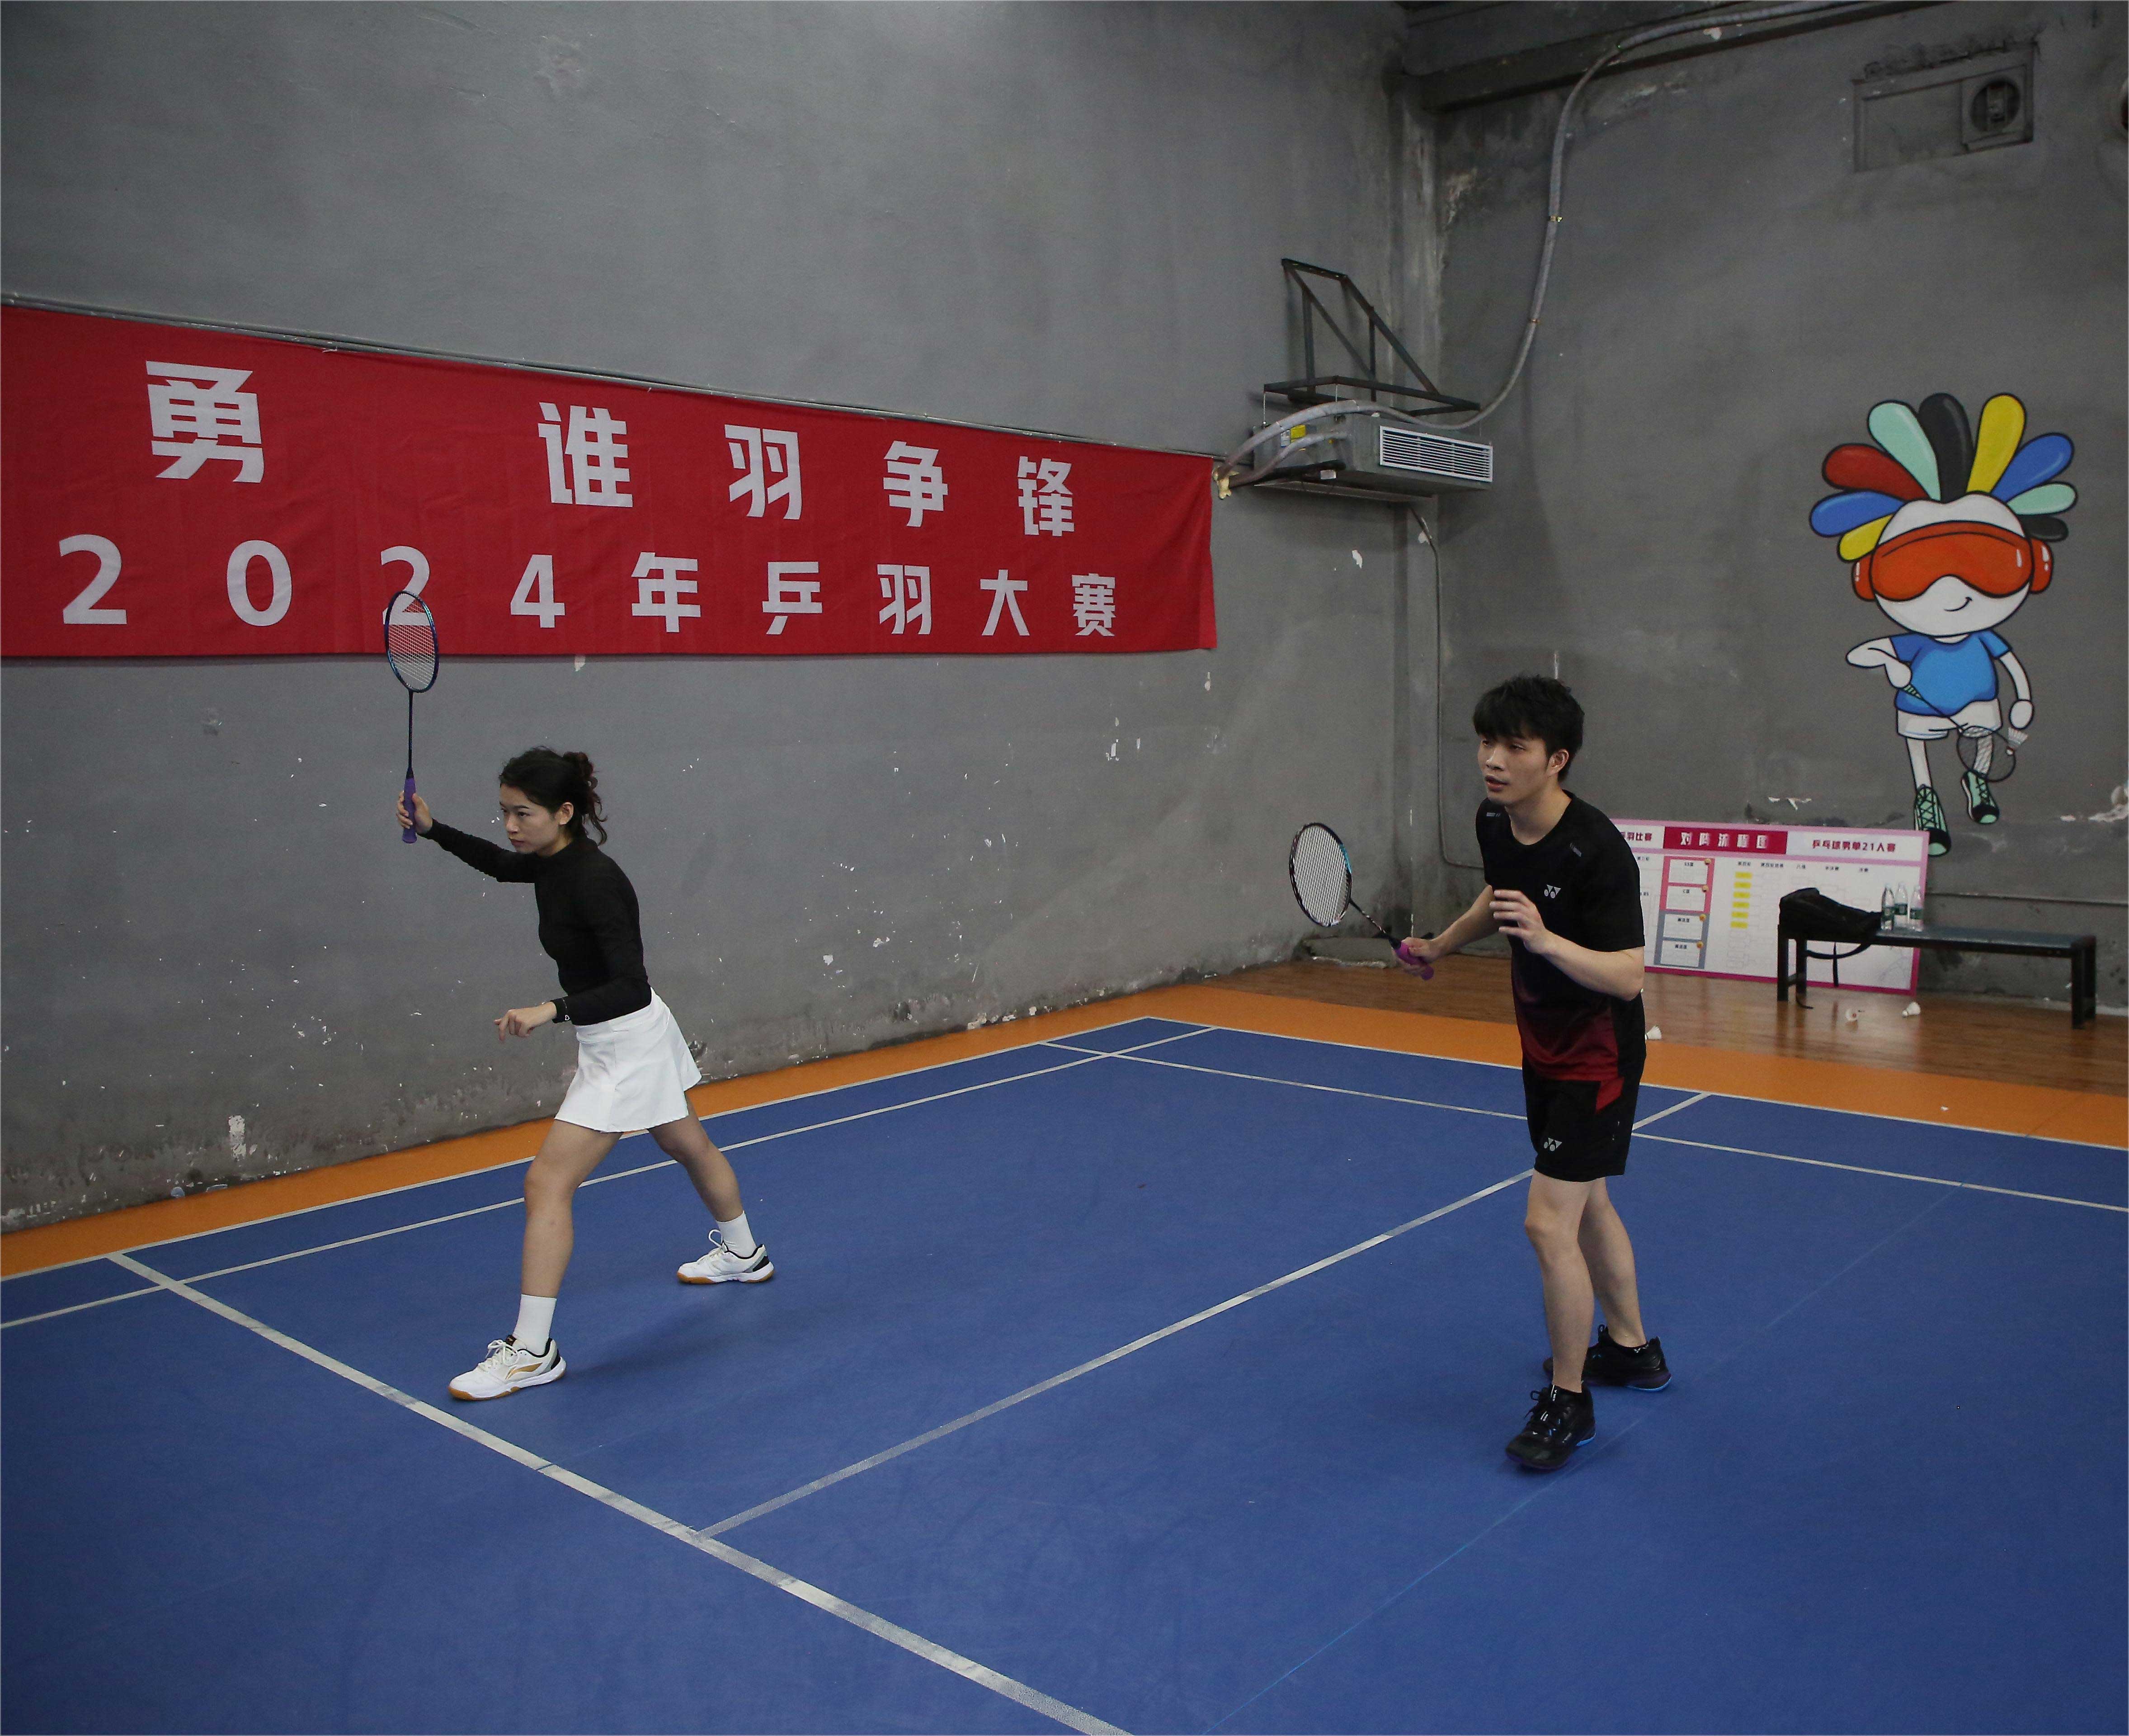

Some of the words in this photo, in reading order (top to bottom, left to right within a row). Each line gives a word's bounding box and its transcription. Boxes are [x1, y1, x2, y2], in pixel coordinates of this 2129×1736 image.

[146, 361, 264, 483] 勇
[537, 402, 1075, 537] 谁羽争锋
[59, 534, 1116, 637] 2024年乒羽大赛
